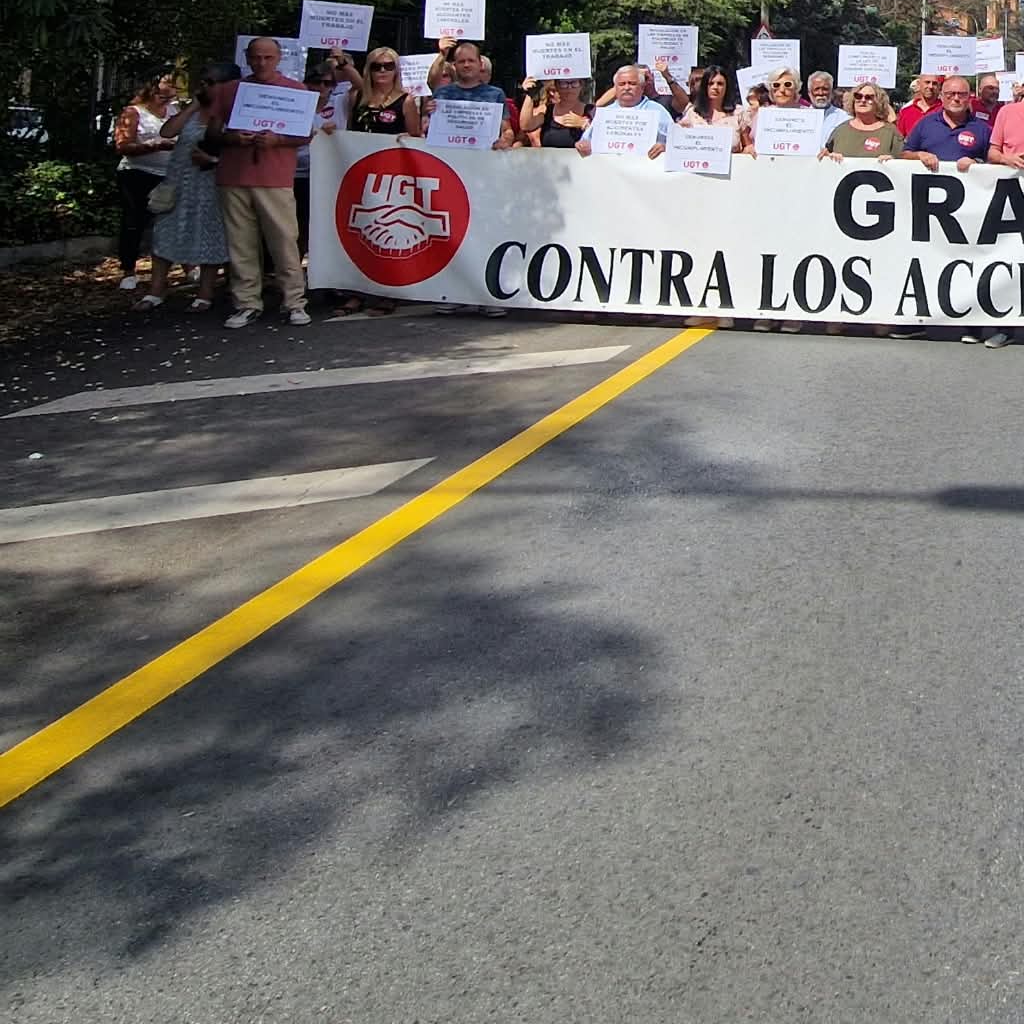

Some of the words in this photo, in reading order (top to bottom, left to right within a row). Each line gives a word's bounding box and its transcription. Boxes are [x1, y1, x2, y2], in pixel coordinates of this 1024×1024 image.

[655, 55, 671, 63] UGT
[544, 67, 562, 76] UGT
[253, 119, 275, 128] UGT
[448, 136, 468, 144] UGT
[865, 139, 881, 148] UGT
[607, 142, 627, 150] UGT
[362, 172, 440, 210] UGT
[485, 241, 733, 309] CONTRA
[757, 254, 872, 315] LOS
